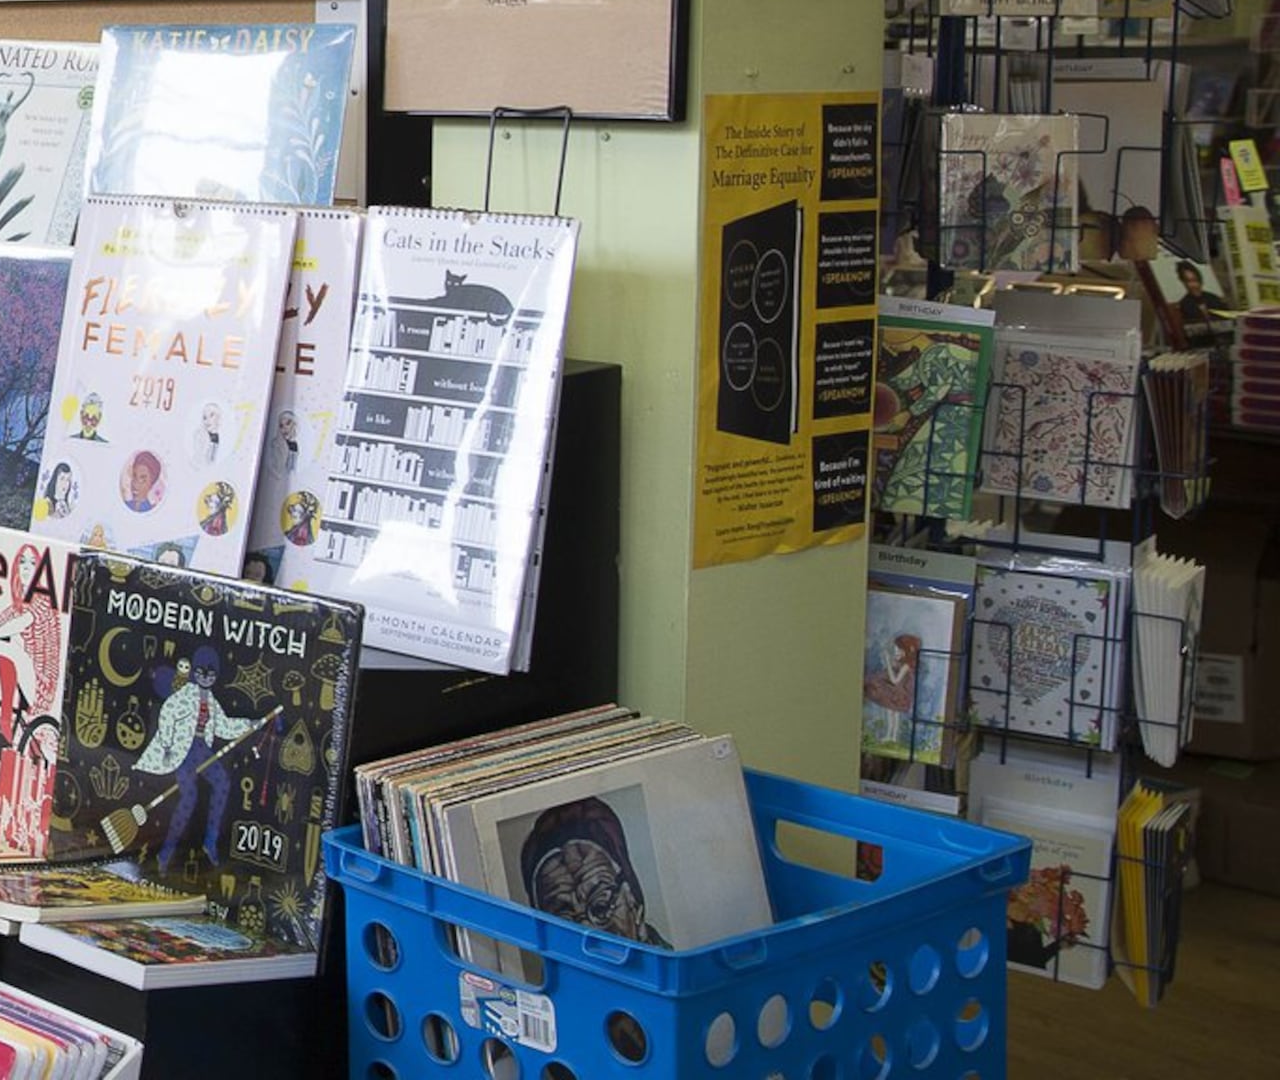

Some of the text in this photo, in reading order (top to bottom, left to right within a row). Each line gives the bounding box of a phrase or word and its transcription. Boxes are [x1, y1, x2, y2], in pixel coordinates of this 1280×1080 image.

[132, 29, 315, 55] KATIE DAISY
[725, 124, 795, 142] The Inside Story
[715, 144, 798, 160] The Definitive Case
[712, 166, 816, 191] Marriage Equality
[383, 229, 555, 261] Cats in the Stacks
[406, 326, 429, 335] room
[82, 322, 244, 369] FEMALE
[128, 376, 178, 412] 2019
[433, 379, 467, 390] without
[878, 551, 927, 568] Birthday
[107, 590, 307, 659] MODERN WITCH
[431, 626, 501, 648] CALENDAR
[236, 826, 284, 861] 2019
